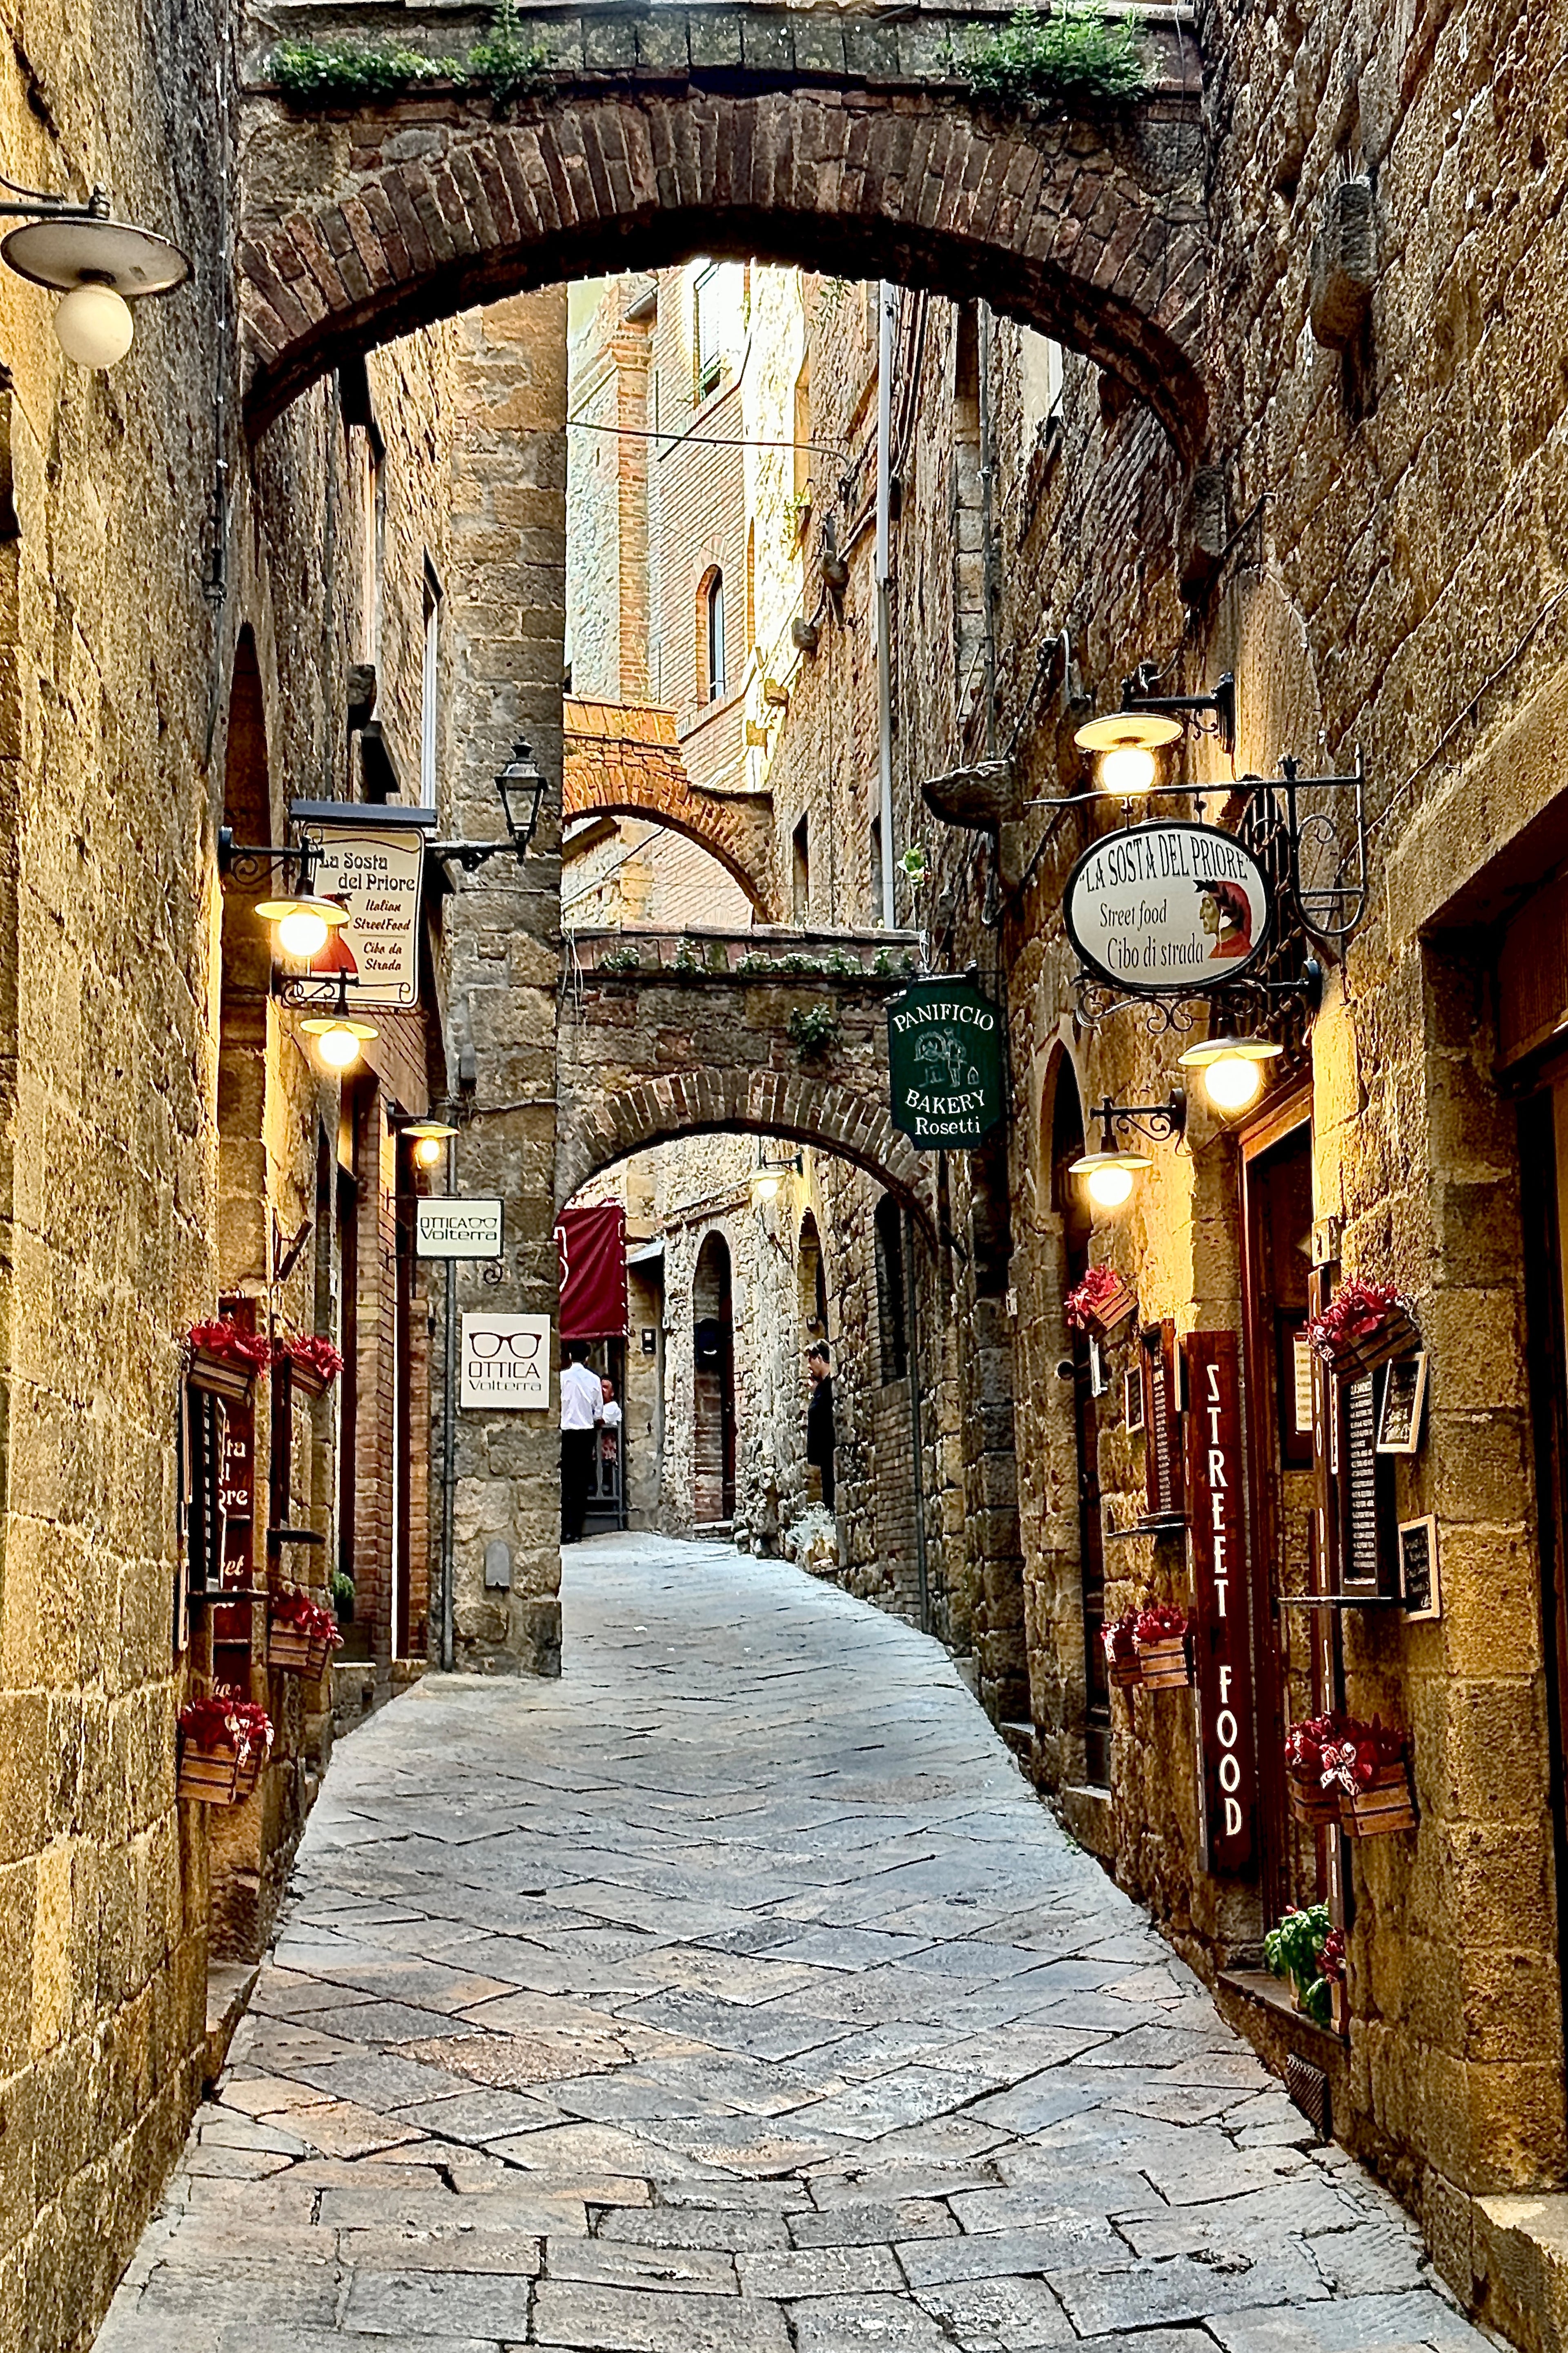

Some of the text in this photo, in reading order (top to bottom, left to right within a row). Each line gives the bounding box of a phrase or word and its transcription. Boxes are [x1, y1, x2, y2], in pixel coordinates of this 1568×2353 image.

[319, 852, 388, 870] La Sosta
[1108, 836, 1158, 886] SOSTA
[1158, 834, 1190, 877] DEL
[339, 873, 414, 891] del Priore
[366, 899, 401, 912] Italian
[1100, 899, 1167, 931] Street food
[363, 941, 385, 954] Cibo
[1107, 933, 1203, 969] Cibo di strada
[365, 958, 401, 971] Strada
[893, 1004, 994, 1033] PANIFICIO
[905, 1088, 986, 1114] BAKERY
[915, 1116, 980, 1135] Rosetti
[421, 1217, 468, 1229] OTTICA
[421, 1229, 497, 1240] Volterra
[468, 1362, 540, 1378] OTTICA
[469, 1380, 541, 1392] Volterra
[1206, 1364, 1242, 1836] STREET FOOD
